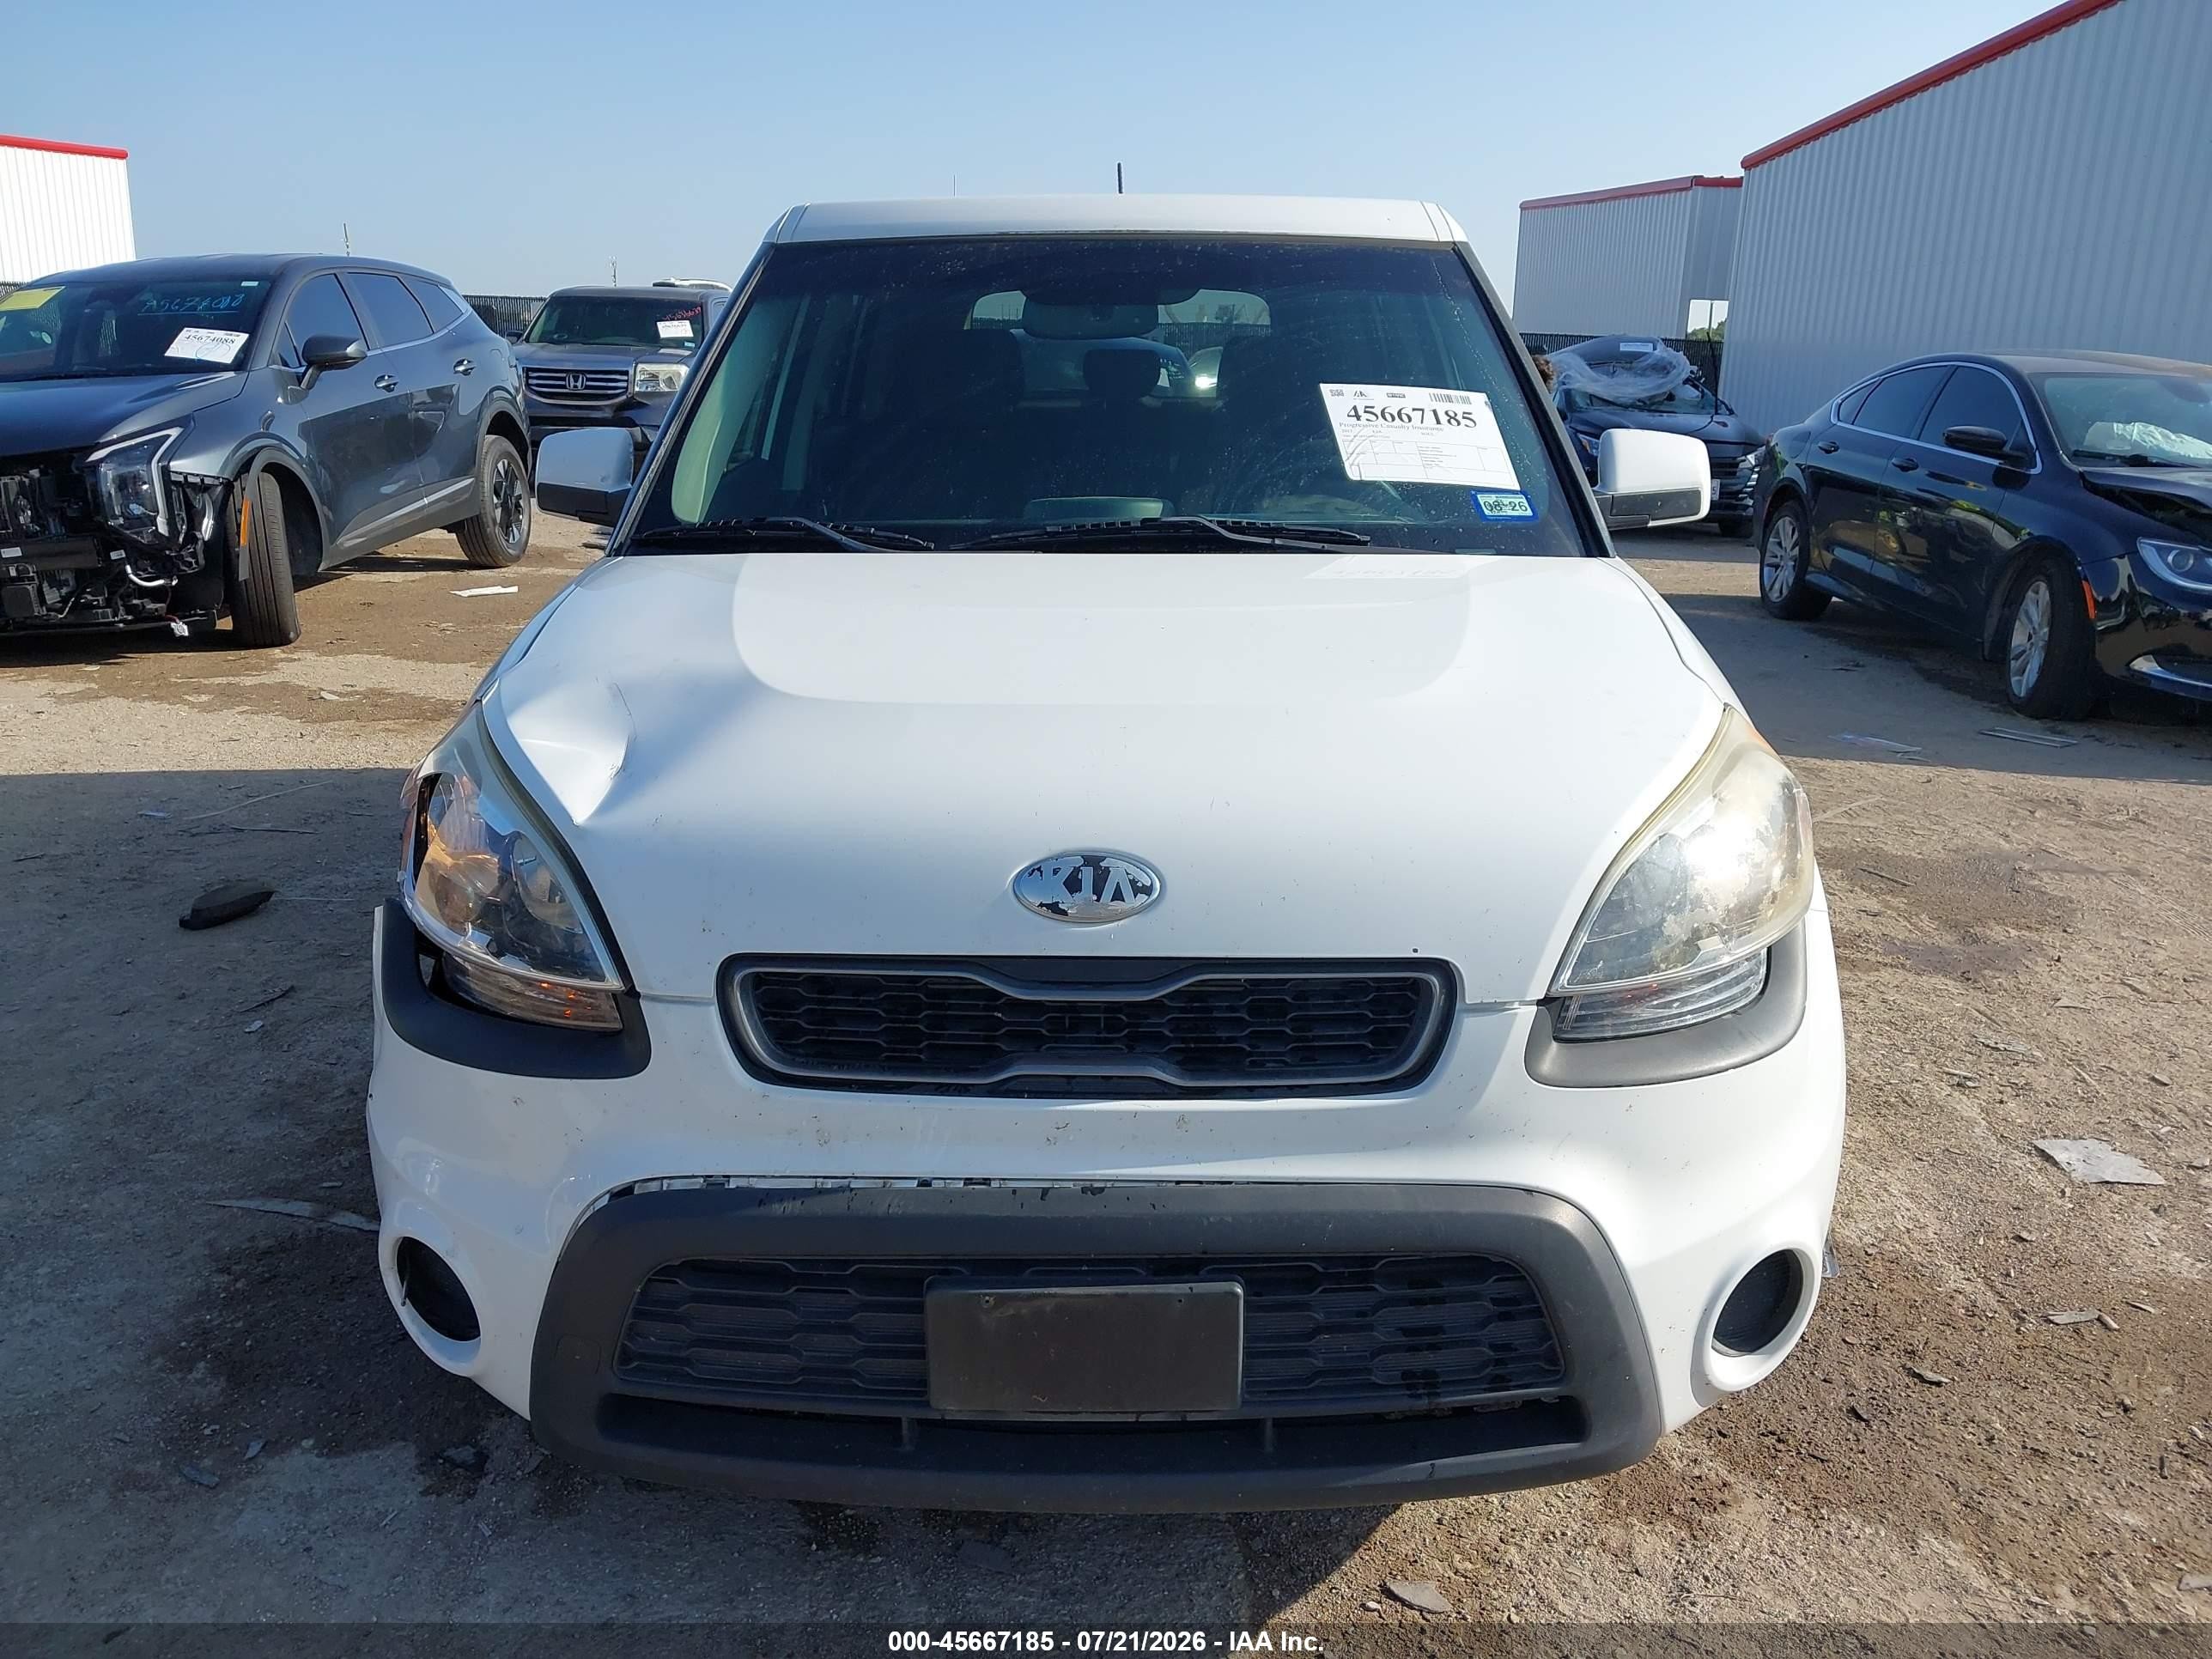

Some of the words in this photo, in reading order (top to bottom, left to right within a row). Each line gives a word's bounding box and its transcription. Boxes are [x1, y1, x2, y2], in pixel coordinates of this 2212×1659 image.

[185, 334, 236, 345] 45674088
[1346, 404, 1477, 428] 45667185
[1340, 421, 1378, 429] Progressive
[1508, 500, 1528, 513] 26
[1042, 861, 1137, 903] KIA
